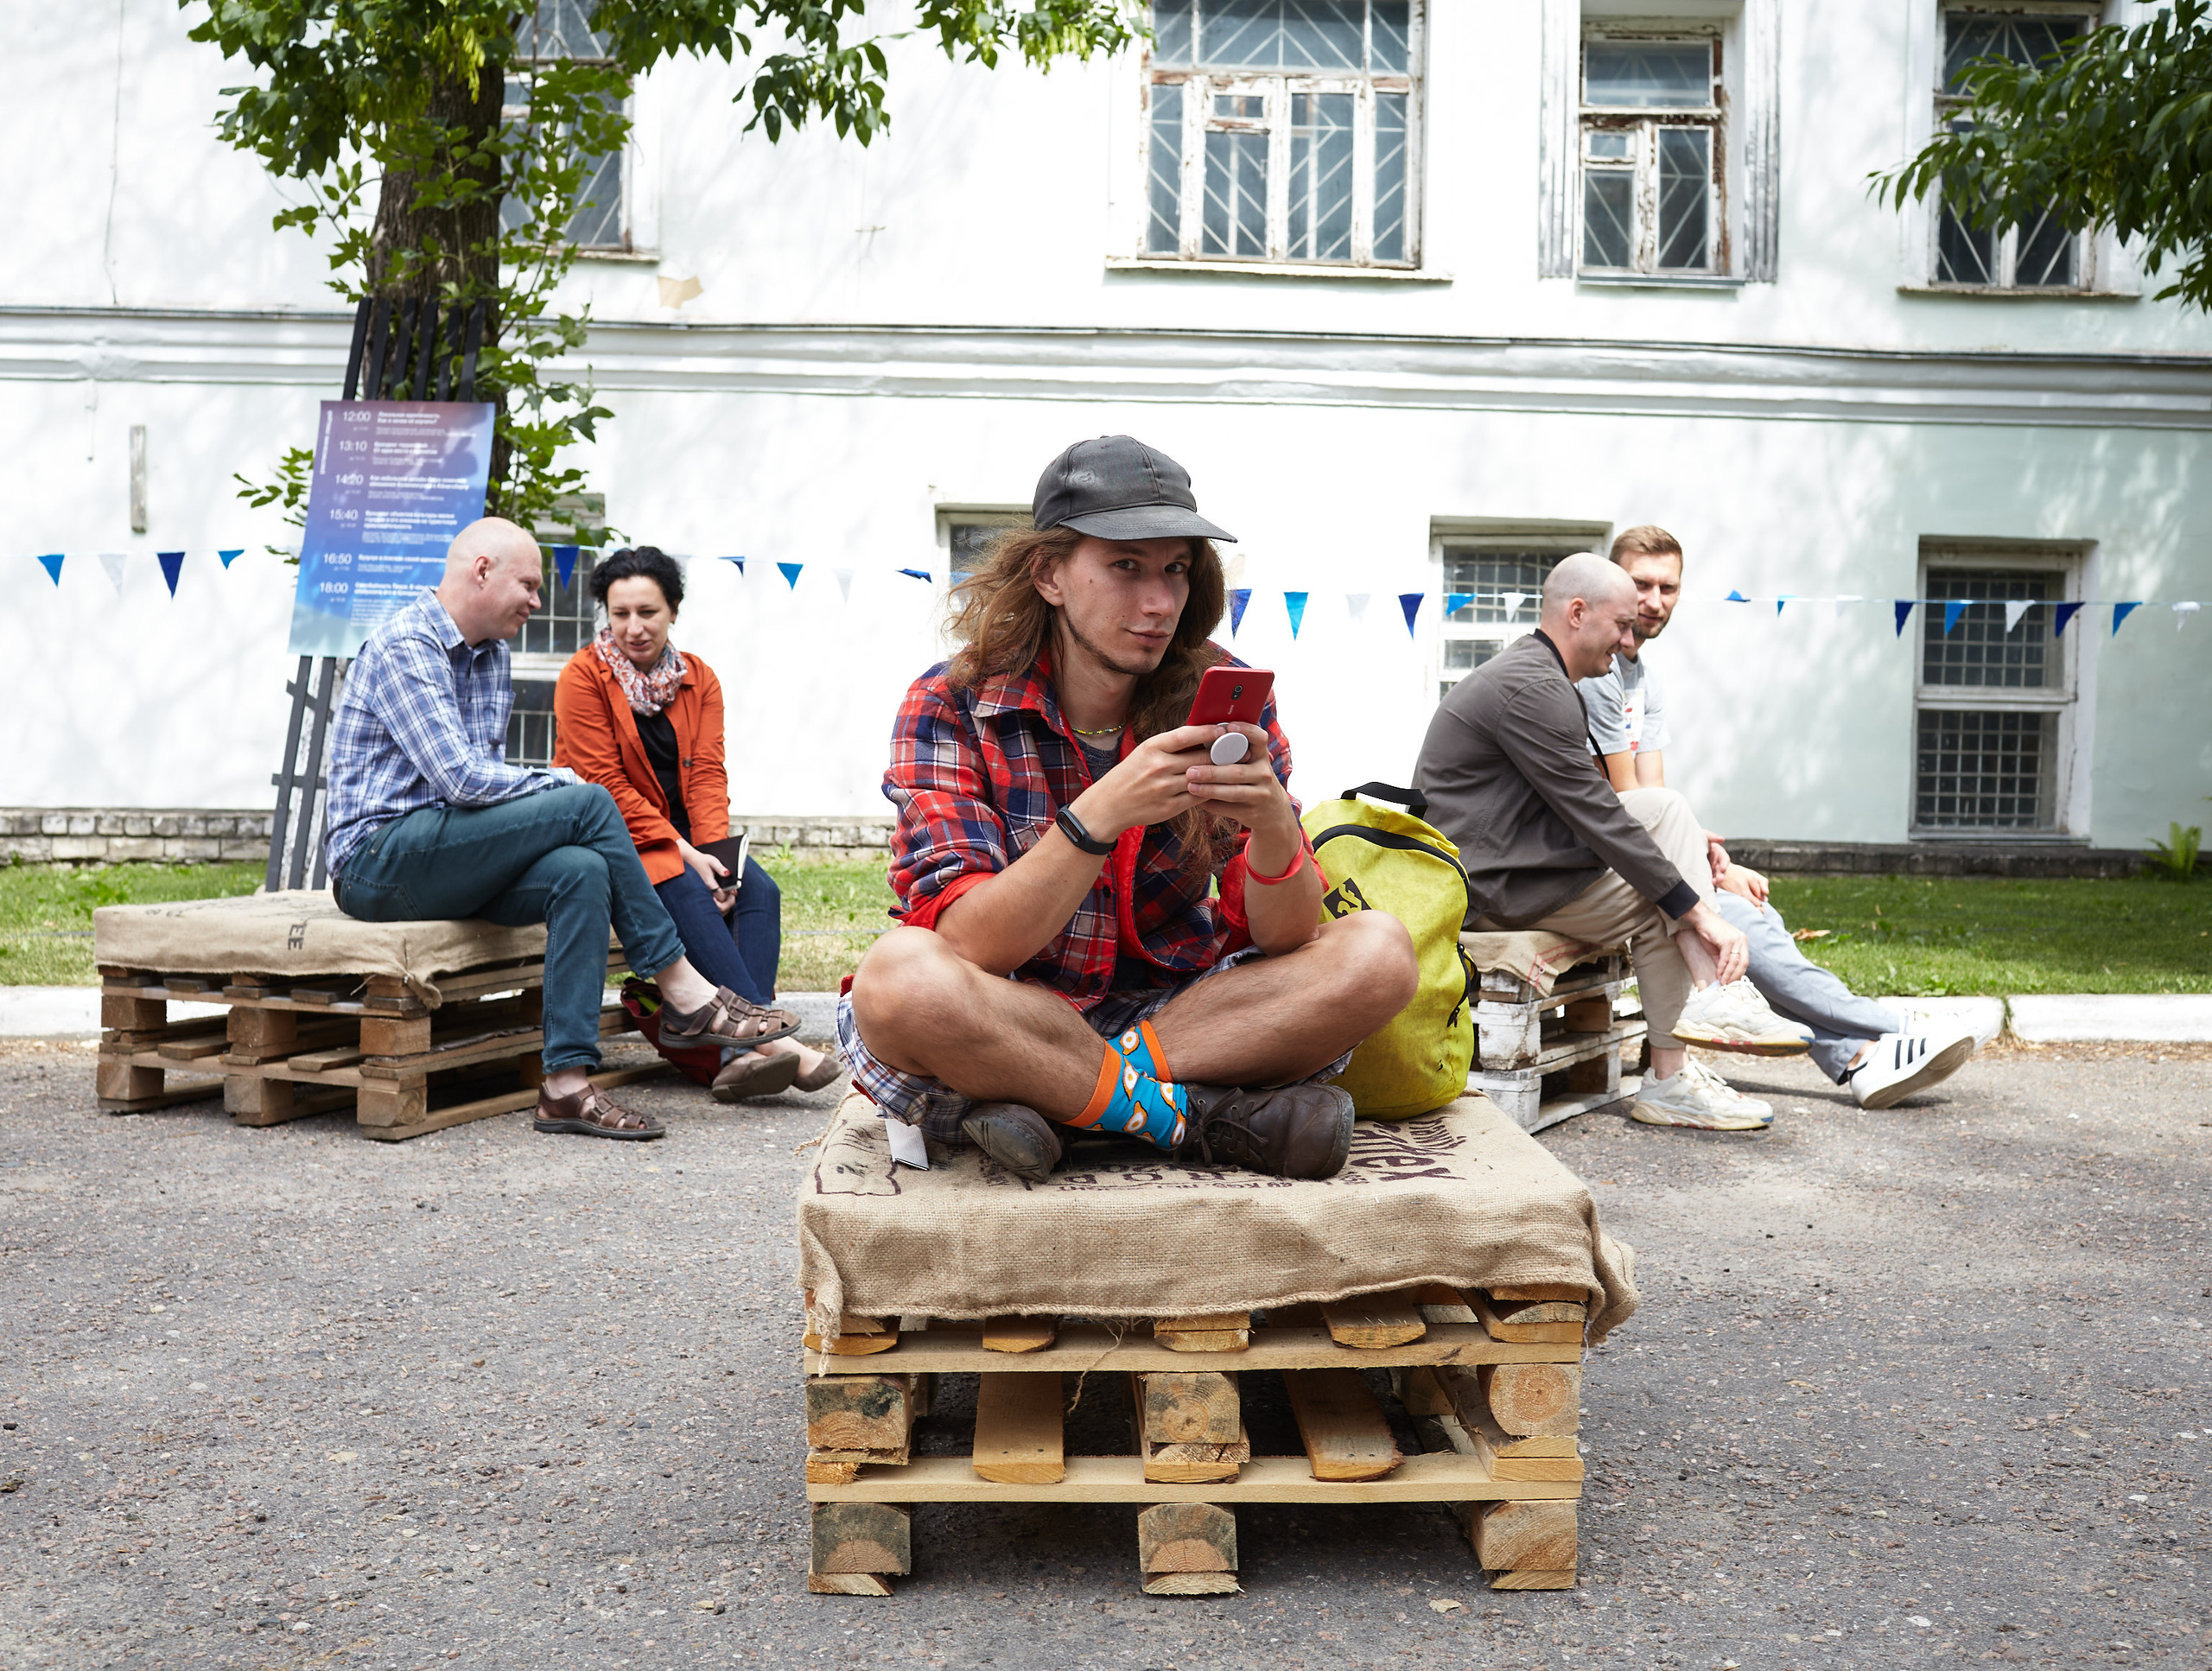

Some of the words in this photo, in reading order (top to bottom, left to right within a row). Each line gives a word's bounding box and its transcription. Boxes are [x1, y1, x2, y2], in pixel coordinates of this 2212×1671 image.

[343, 410, 372, 423] 12:00
[340, 440, 368, 452] 13:10
[335, 474, 364, 486] 14:20
[329, 509, 359, 521] 15:40
[323, 552, 353, 565] 16:50
[319, 581, 349, 594] 18:00
